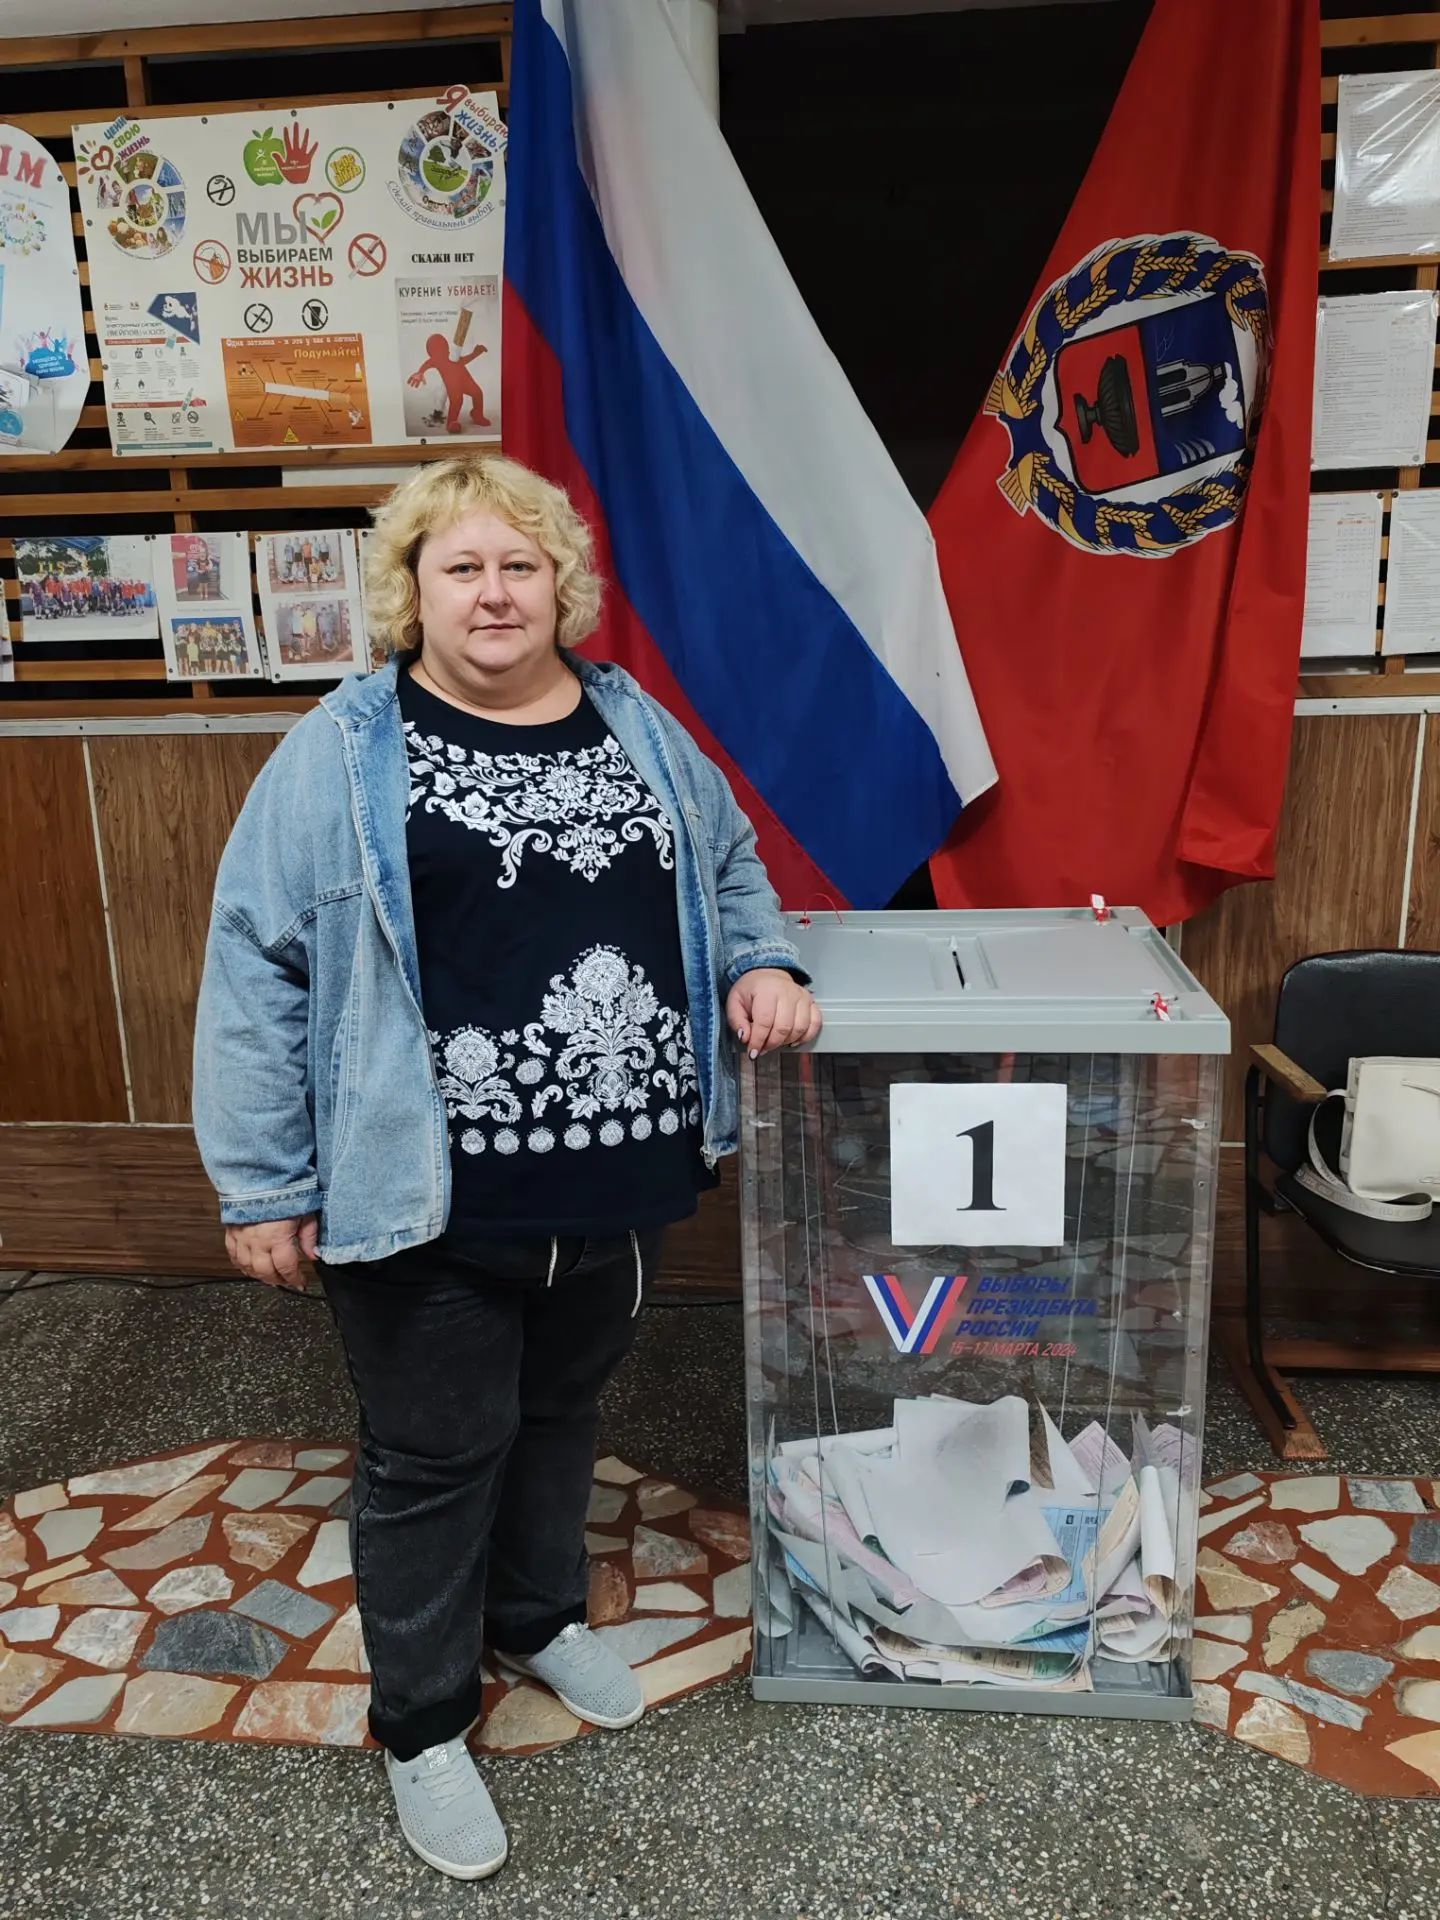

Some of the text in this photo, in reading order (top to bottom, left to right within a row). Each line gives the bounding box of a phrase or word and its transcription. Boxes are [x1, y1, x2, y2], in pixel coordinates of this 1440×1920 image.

[436, 86, 468, 113] Я
[104, 117, 128, 140] ЦЕНИ
[113, 123, 141, 148] СВОЮ
[118, 136, 151, 160] ЖИЗНЬ
[467, 201, 494, 224] выбор
[236, 211, 308, 245] МЫ
[237, 247, 333, 263] ВЫБИРАЕМ
[411, 252, 475, 263] СКАЖИ НЕТ
[239, 265, 334, 288] ЖИЗНЬ
[398, 284, 496, 297] КУРЕНИЕ УБИВАЕТ!
[293, 346, 360, 359] Подумайте!
[956, 1120, 1007, 1211] 1
[977, 1276, 1072, 1293] ВЫБОРЫ
[966, 1299, 1097, 1317] ПРЕЗИДЕНТА
[956, 1320, 1040, 1337] РОССИИ
[992, 1341, 1040, 1356] МАРТА
[1041, 1342, 1078, 1357] 2024
